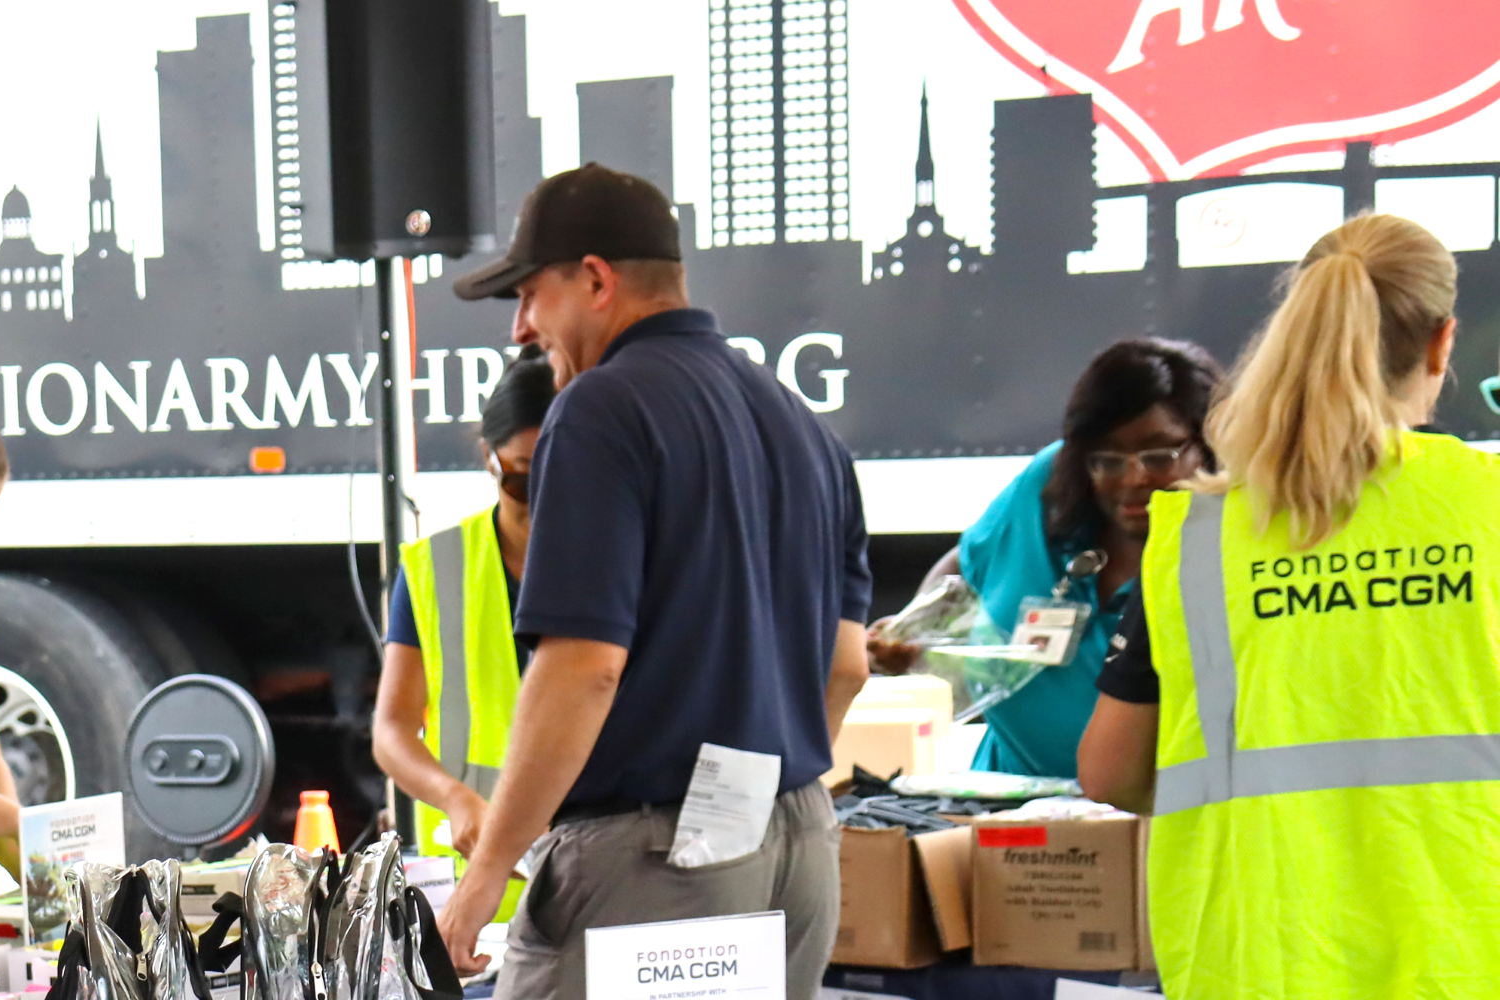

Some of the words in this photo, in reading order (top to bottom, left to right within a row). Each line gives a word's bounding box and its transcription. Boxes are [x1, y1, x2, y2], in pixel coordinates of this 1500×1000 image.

[1253, 581, 1357, 619] CMA
[1367, 570, 1473, 608] CGM
[51, 828, 72, 842] CMA
[74, 824, 96, 837] CGM
[1003, 847, 1099, 866] freshmint
[638, 964, 685, 984] CMA
[690, 959, 738, 979] CGM
[658, 990, 707, 1000] PARTNERSHIP
[708, 988, 727, 996] WITH
